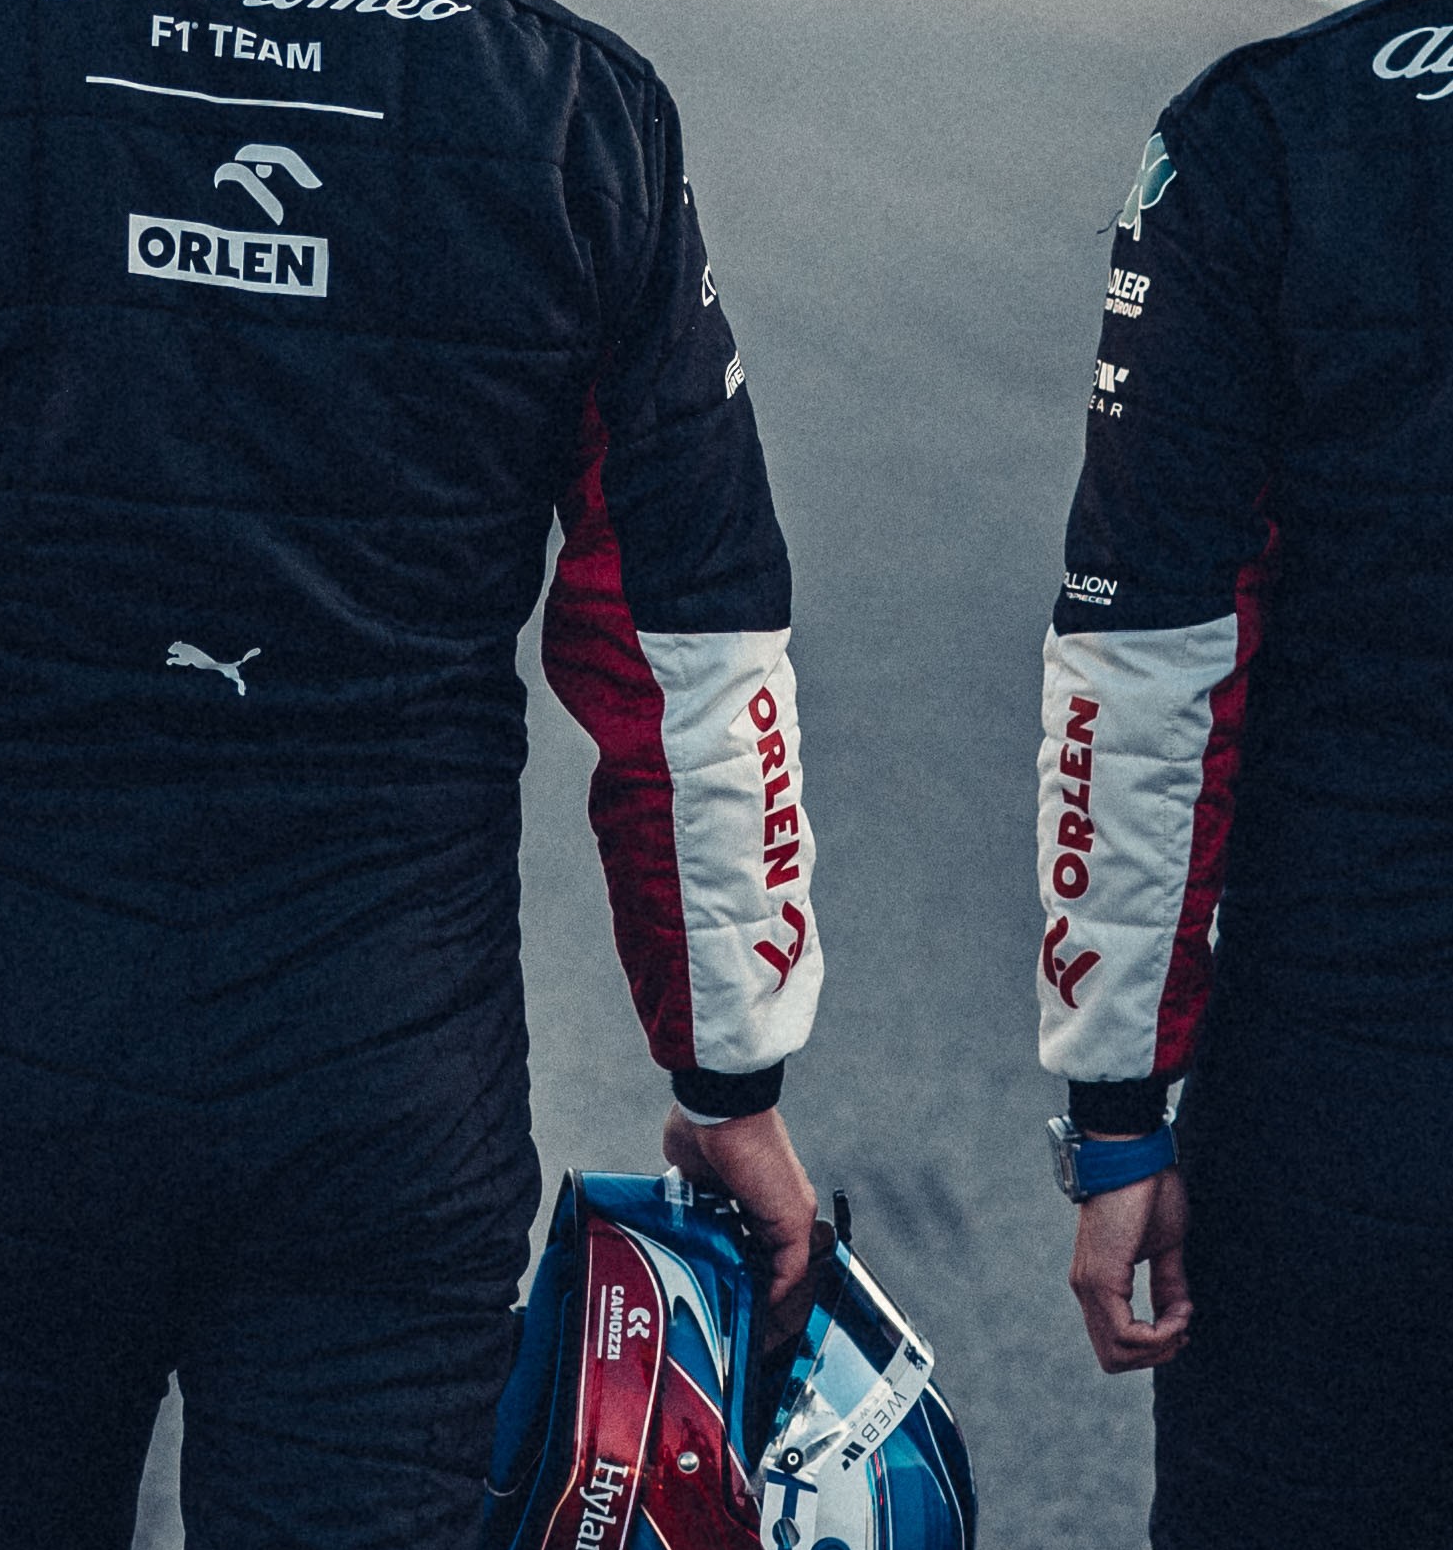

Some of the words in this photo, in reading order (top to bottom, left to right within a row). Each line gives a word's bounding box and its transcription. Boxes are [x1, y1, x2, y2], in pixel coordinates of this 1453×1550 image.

[208, 22, 322, 72] TEAM
[137, 225, 316, 287] ORLEN
[748, 685, 803, 891] ORLEN
[1051, 695, 1101, 899] ORLEN
[607, 1285, 624, 1360] CAMOZZI
